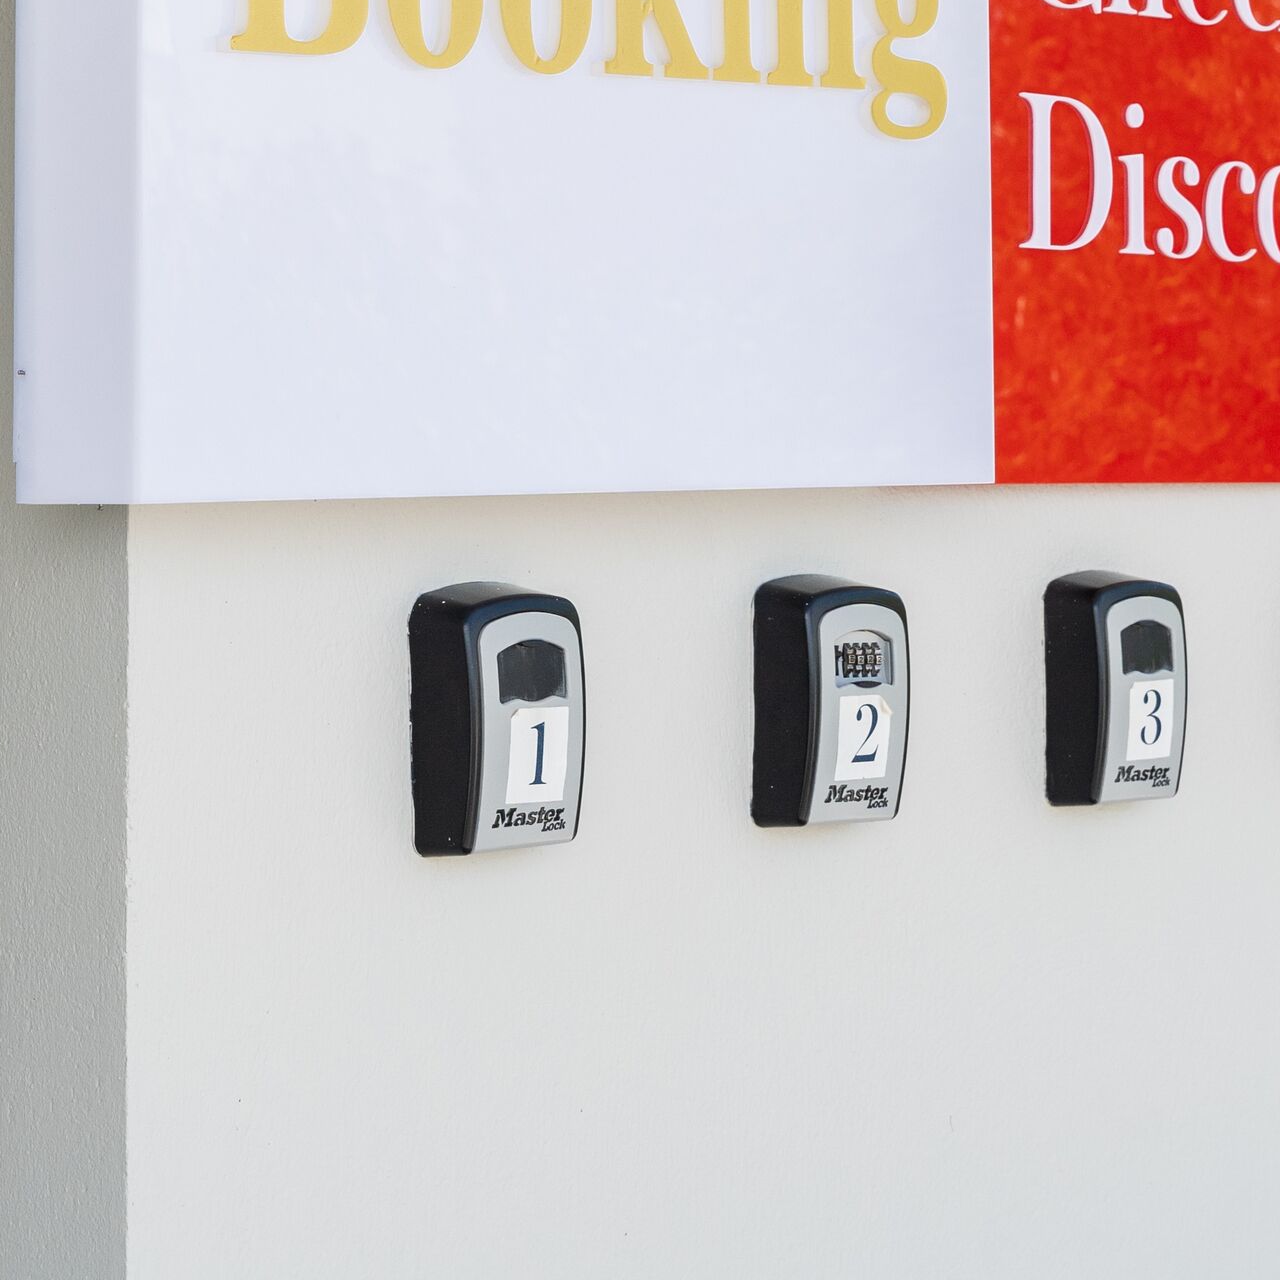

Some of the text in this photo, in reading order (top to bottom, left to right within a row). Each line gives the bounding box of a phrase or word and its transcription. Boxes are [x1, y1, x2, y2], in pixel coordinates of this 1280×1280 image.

[1140, 689, 1162, 745] 3
[851, 703, 879, 763] 2
[528, 721, 547, 786] 1
[1114, 764, 1170, 783] Master
[824, 784, 889, 803] Master
[867, 797, 889, 809] Lock
[491, 806, 565, 829] Master
[541, 818, 566, 832] Lock
